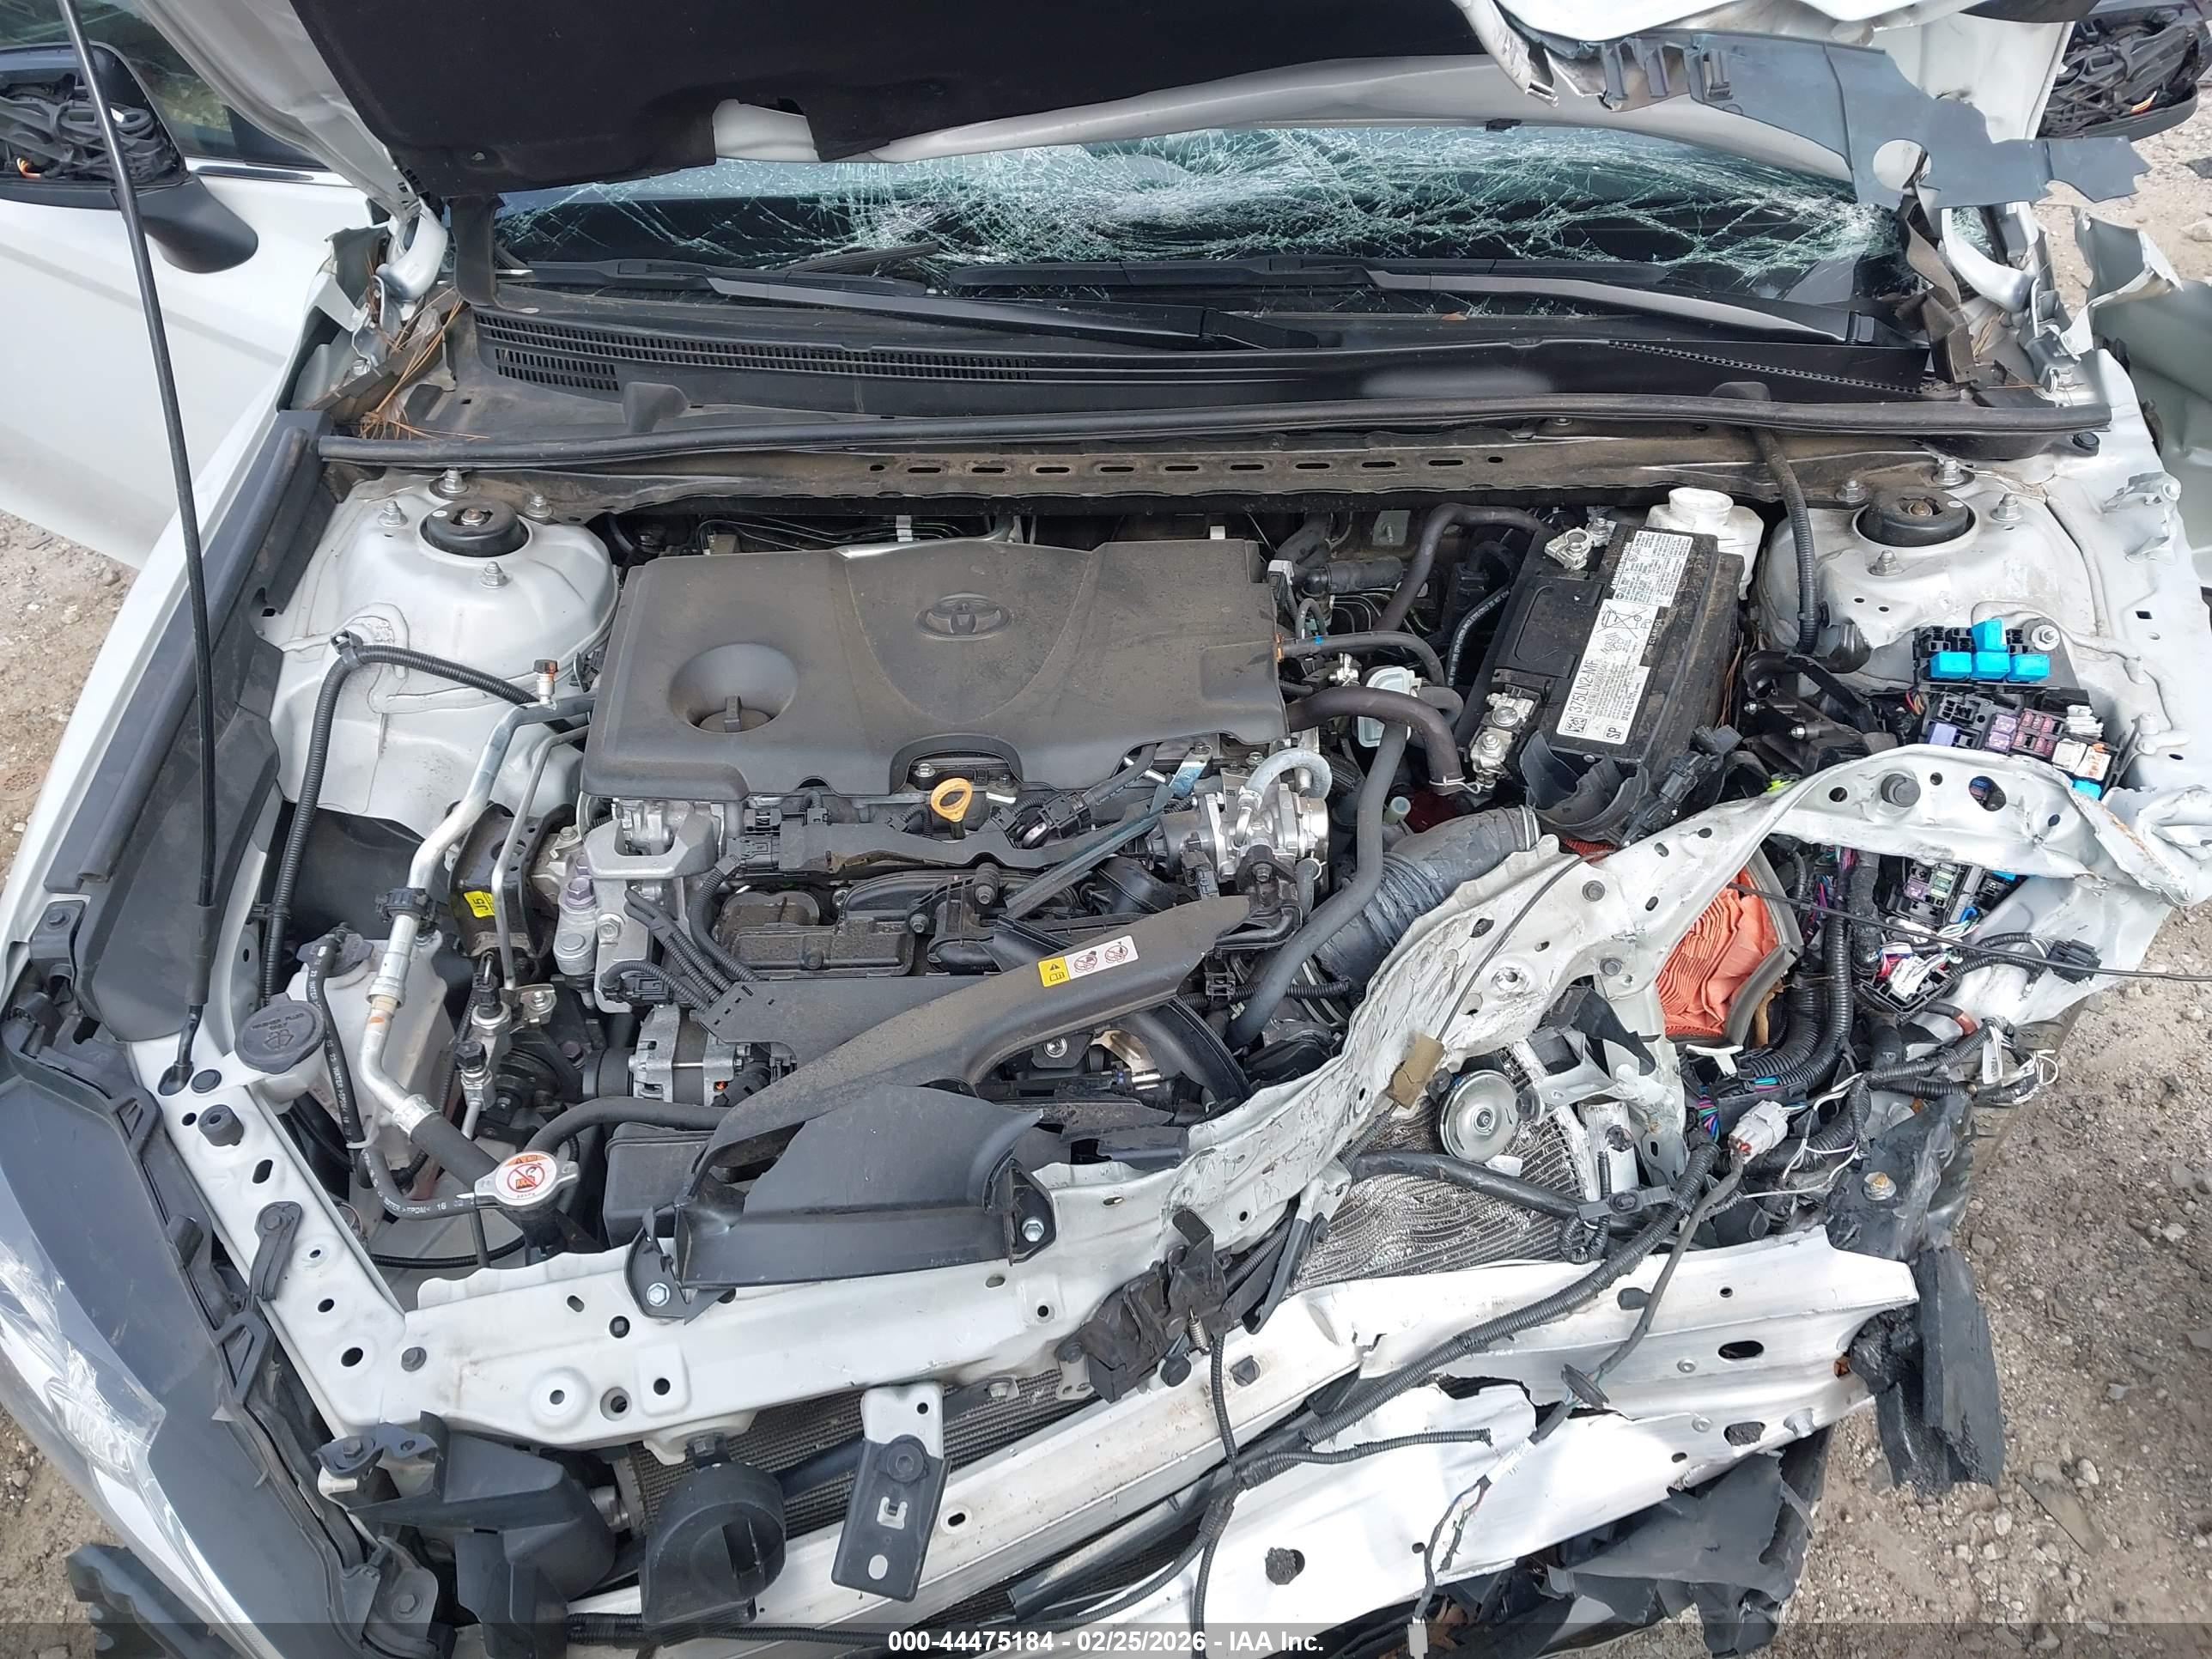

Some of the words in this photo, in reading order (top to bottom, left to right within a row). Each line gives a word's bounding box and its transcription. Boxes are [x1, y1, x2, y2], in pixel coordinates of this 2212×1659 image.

[1568, 659, 1598, 713] 375LN2-MF
[1606, 726, 1622, 739] SP
[472, 898, 489, 911] J5
